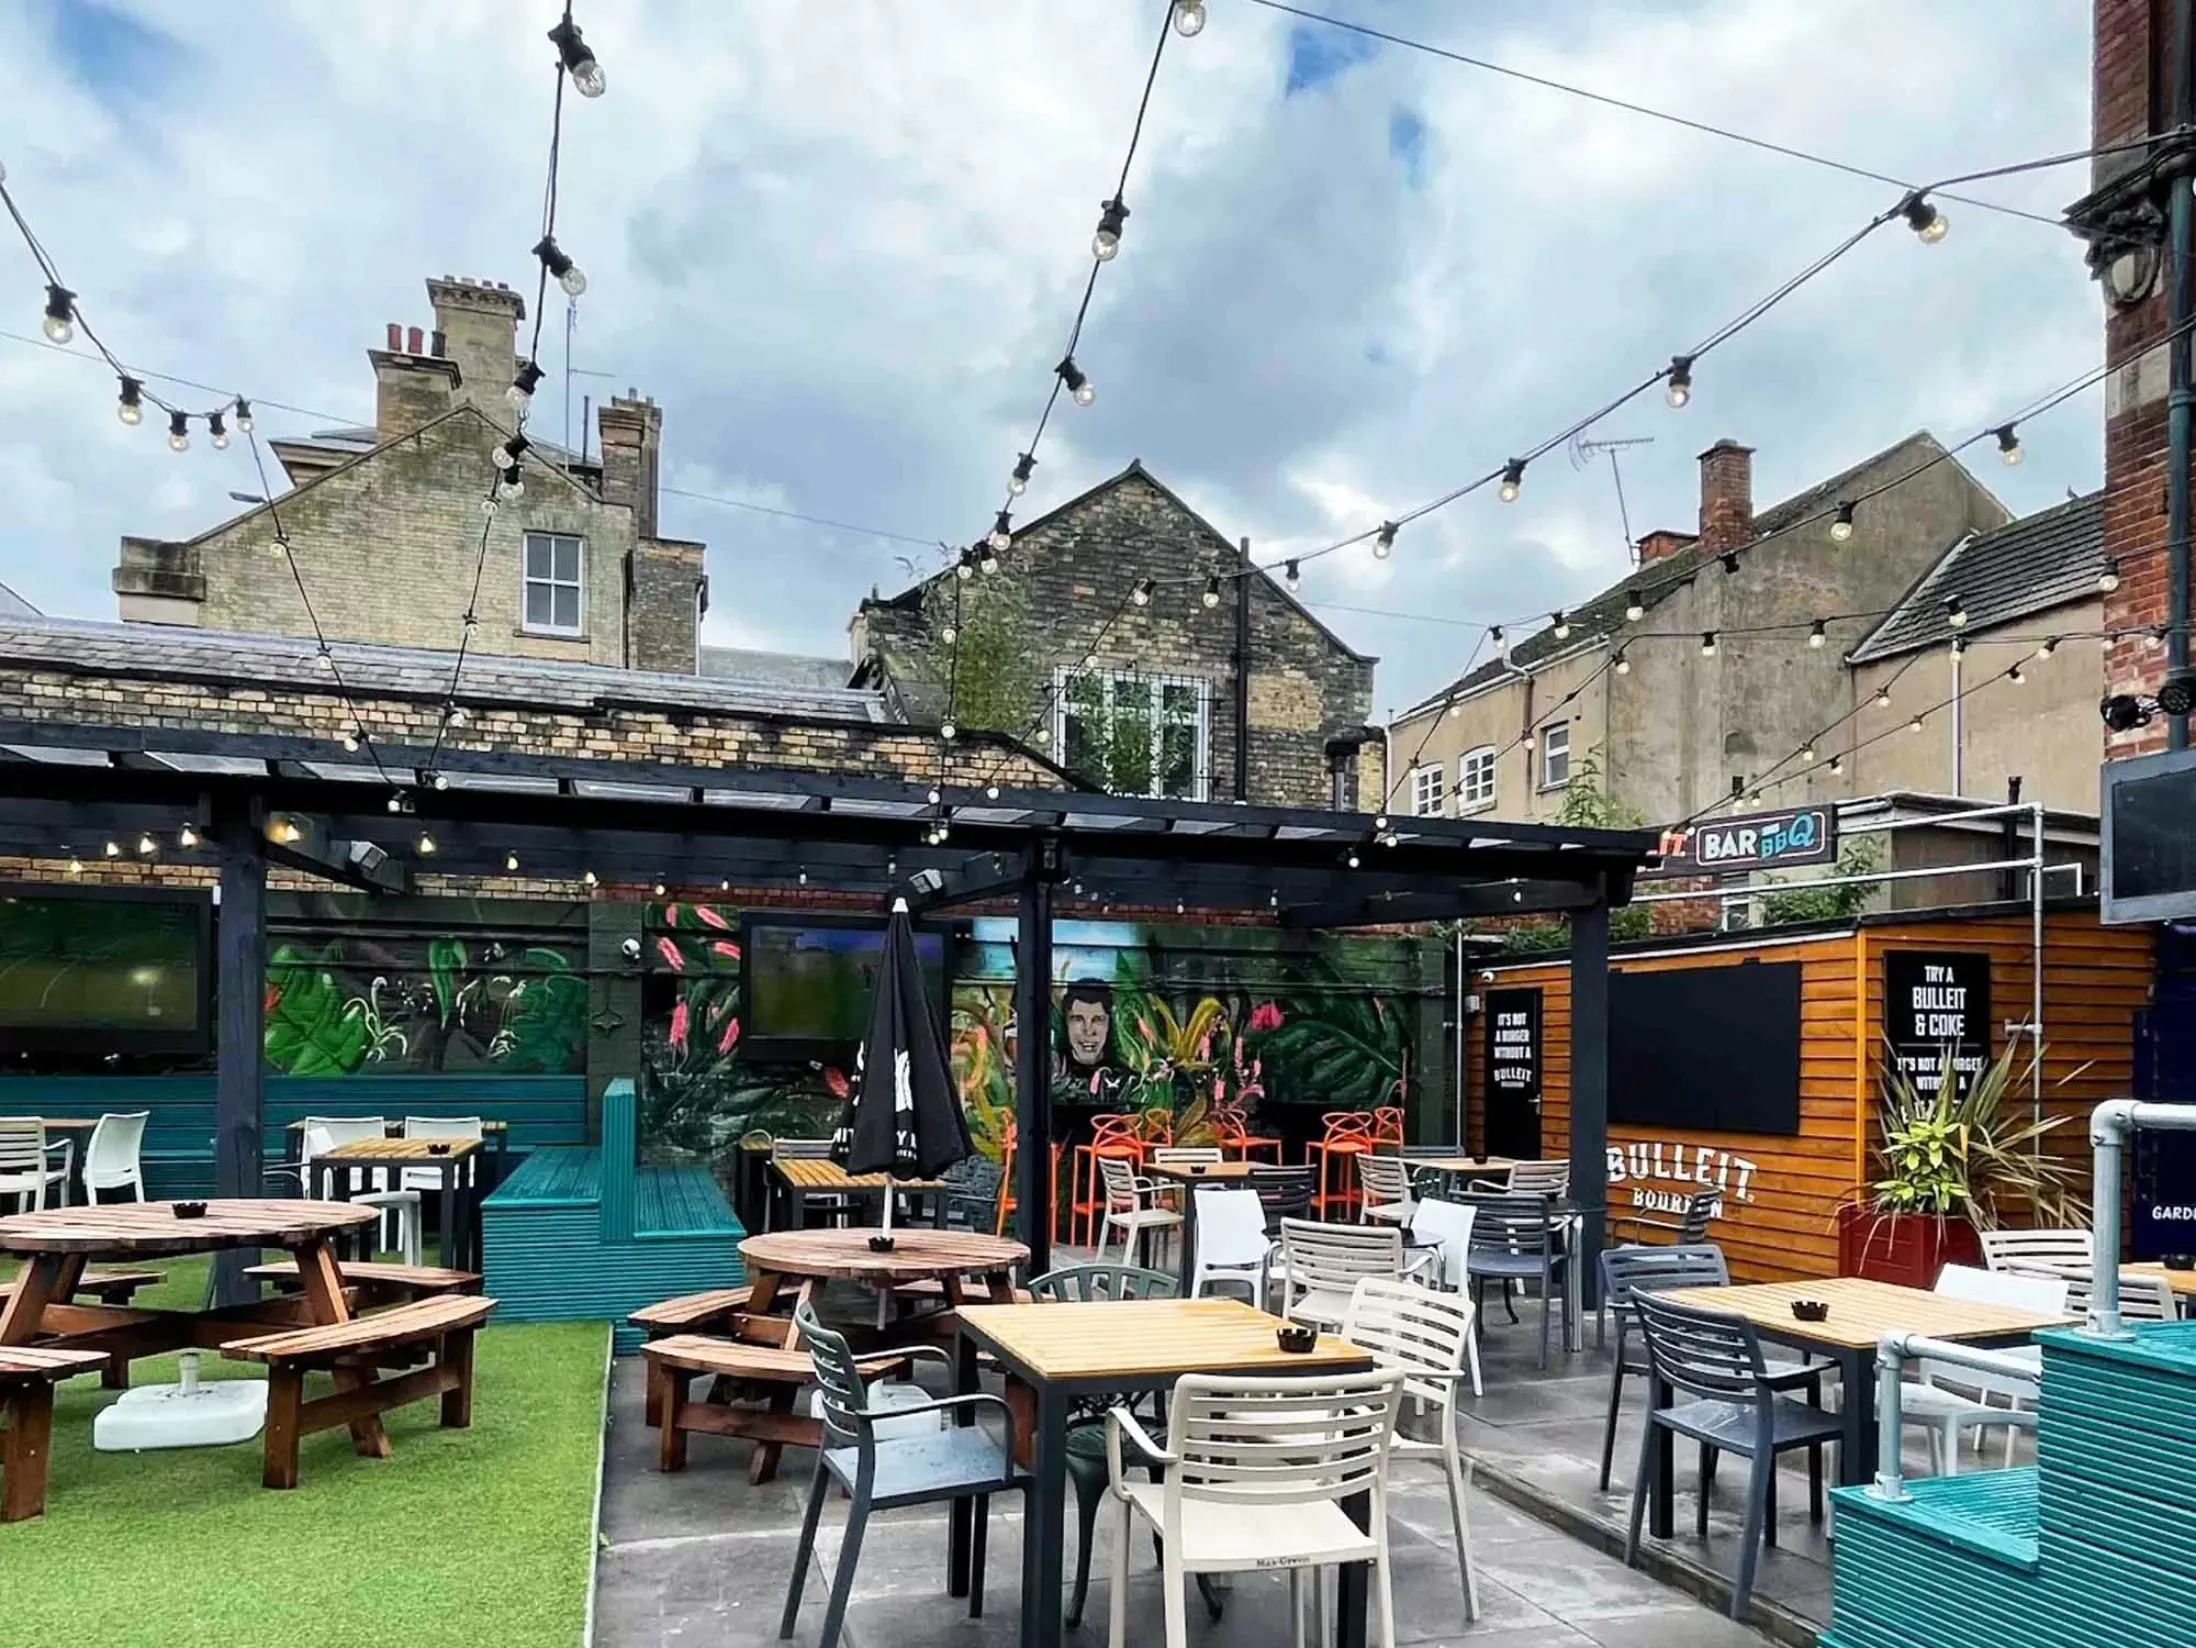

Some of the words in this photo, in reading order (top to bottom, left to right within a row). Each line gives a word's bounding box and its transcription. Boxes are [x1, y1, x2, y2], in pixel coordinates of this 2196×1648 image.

[1704, 830, 1757, 860] BAR
[1760, 813, 1815, 860] BBQ
[1925, 966, 1944, 983] TRY
[1946, 967, 1954, 983] A
[1912, 987, 1966, 1010] BULLEIT
[1915, 1014, 1926, 1036] &
[1929, 1014, 1966, 1036] COKE
[1525, 1046, 1532, 1059] A
[1917, 1057, 1936, 1071] NOT
[1494, 1067, 1532, 1082] BULLEIT
[1959, 1076, 1967, 1090] A
[1605, 1143, 1757, 1202] BULLEIT
[2152, 1205, 2196, 1221] GARD
